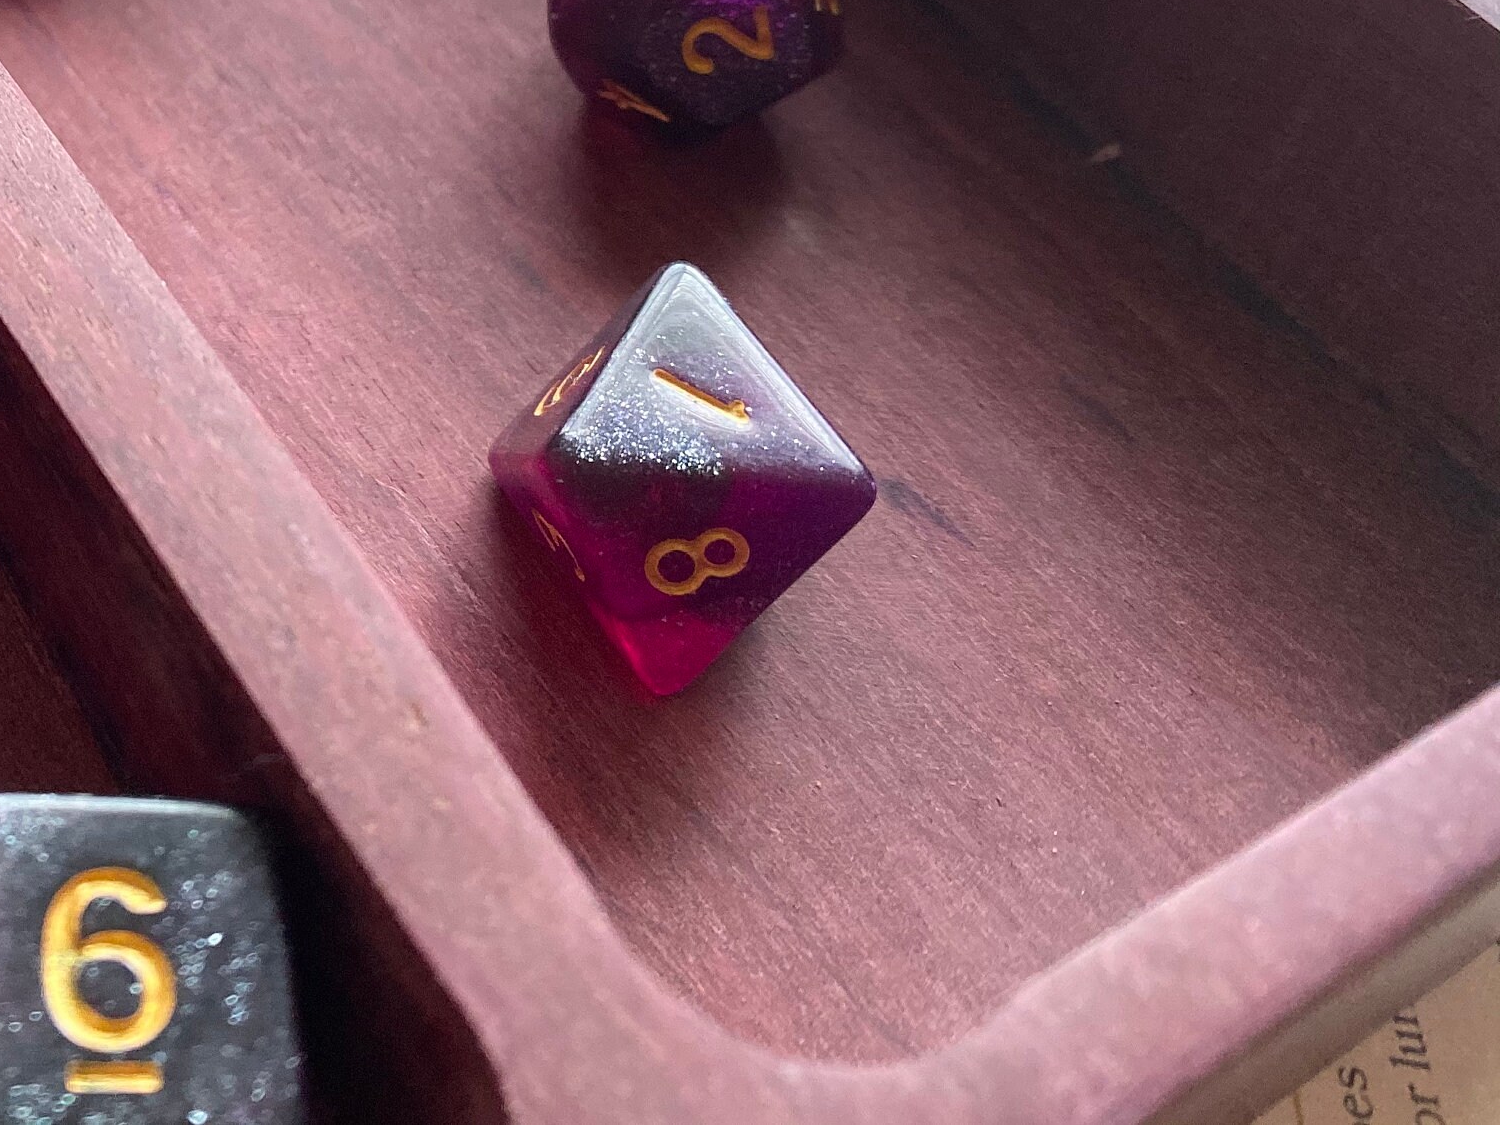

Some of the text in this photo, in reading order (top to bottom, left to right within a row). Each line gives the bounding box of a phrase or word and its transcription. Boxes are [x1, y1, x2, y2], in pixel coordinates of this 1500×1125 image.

[681, 4, 776, 75] 2
[652, 368, 752, 425] 1
[644, 526, 752, 597] 8
[40, 866, 178, 1054] 6
